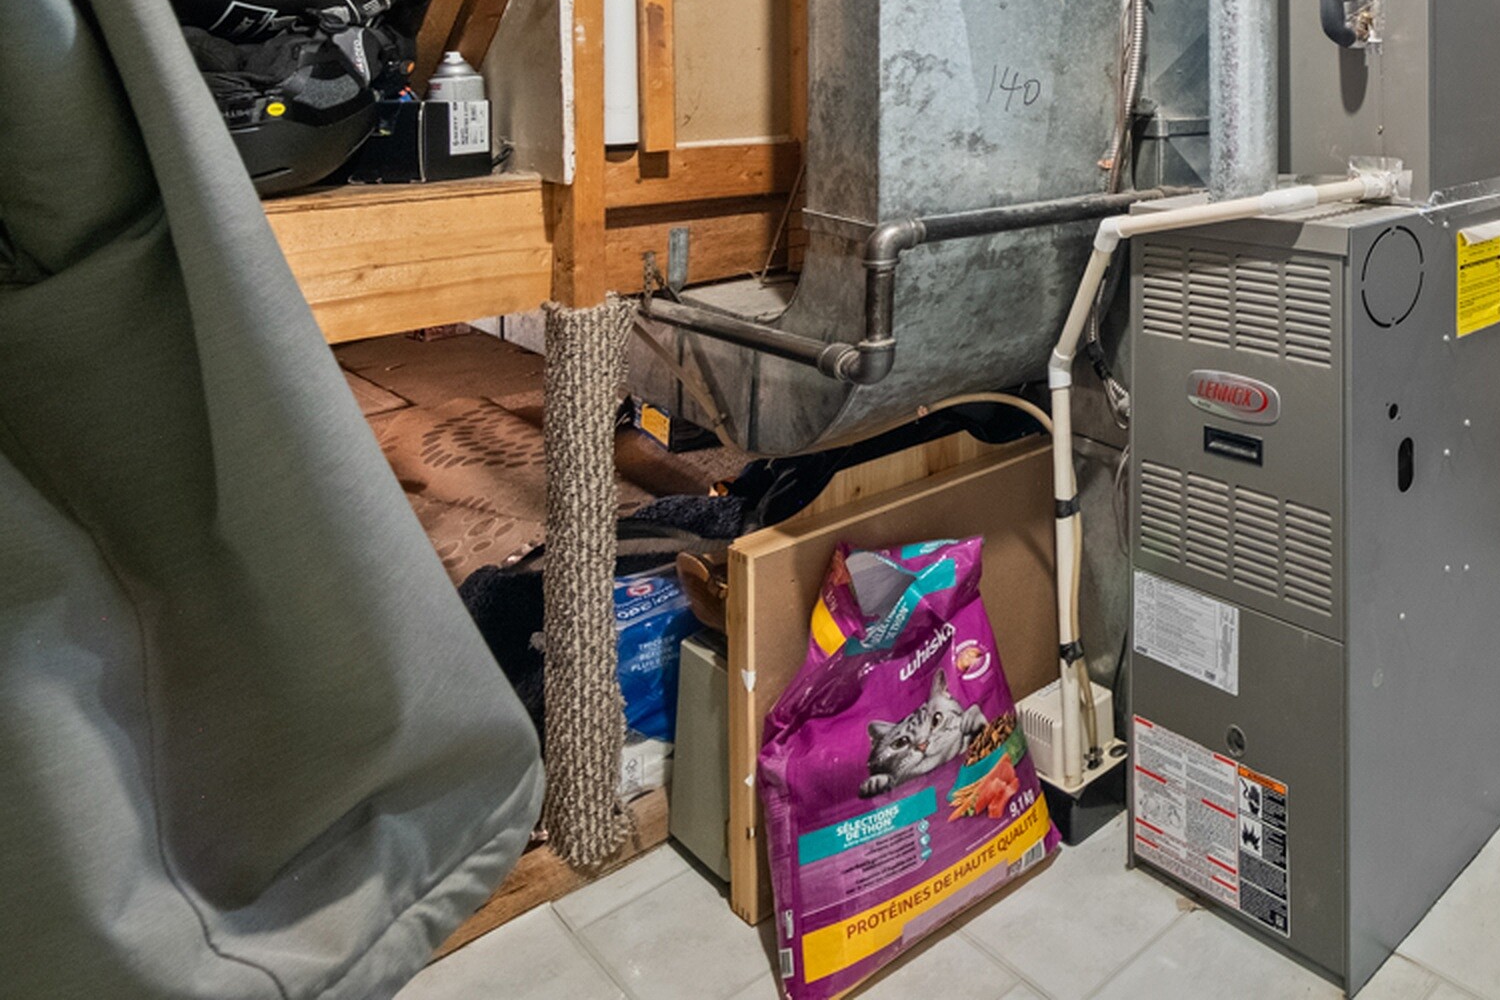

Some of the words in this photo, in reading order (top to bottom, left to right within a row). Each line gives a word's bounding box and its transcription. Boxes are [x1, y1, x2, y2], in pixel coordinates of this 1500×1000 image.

[986, 65, 1041, 112] 140
[1196, 378, 1253, 408] LENNOX
[846, 885, 932, 940] PROTÉINES
[932, 874, 953, 895] DE
[953, 849, 997, 886] HAUTE
[996, 808, 1040, 853] QUALITÉ
